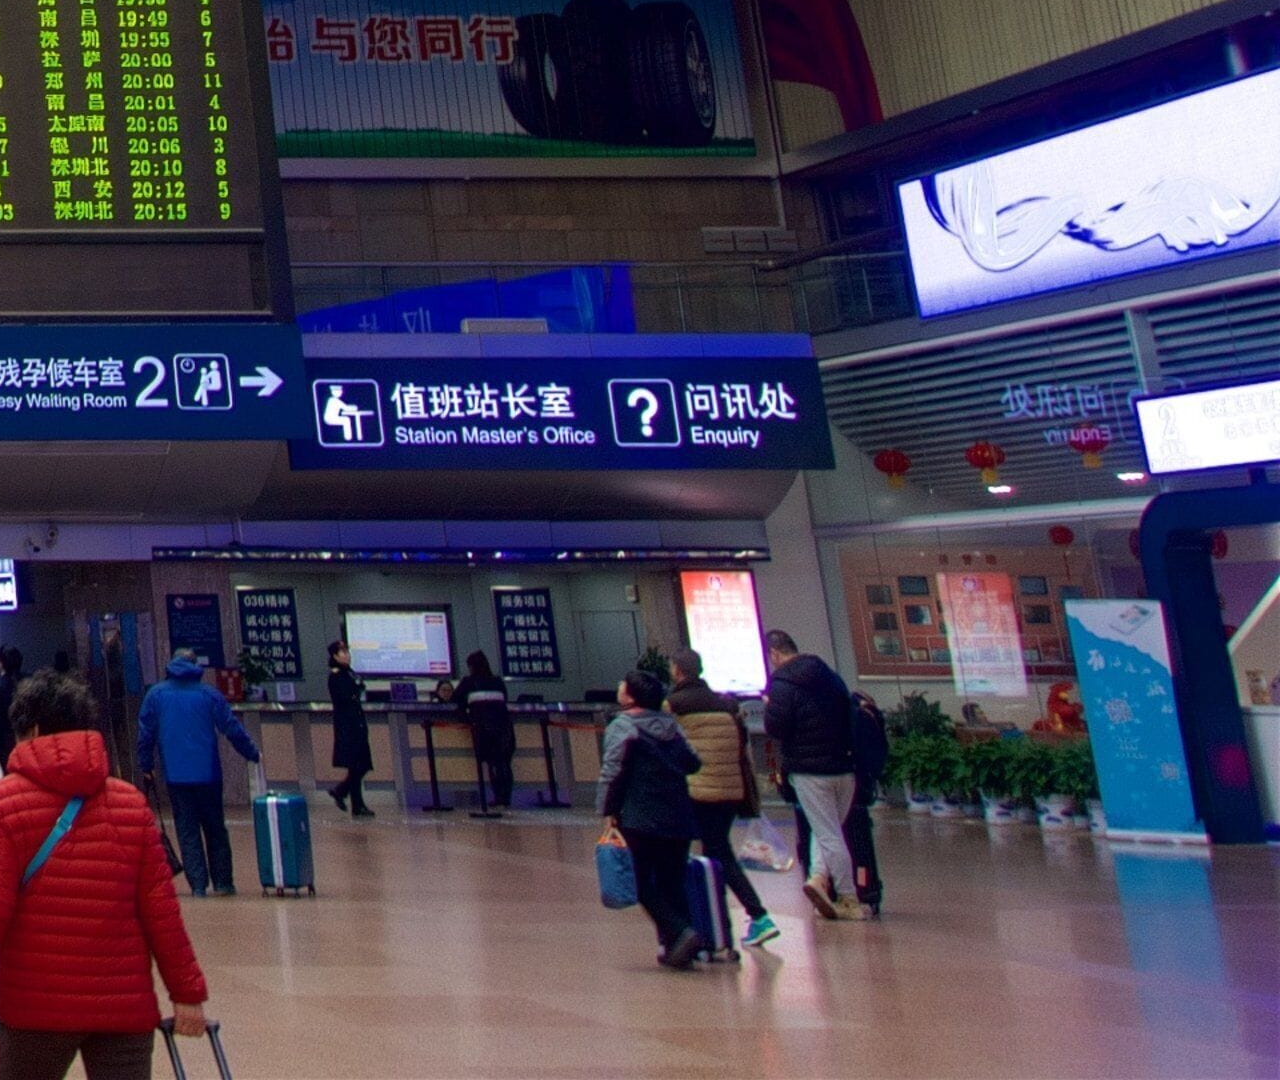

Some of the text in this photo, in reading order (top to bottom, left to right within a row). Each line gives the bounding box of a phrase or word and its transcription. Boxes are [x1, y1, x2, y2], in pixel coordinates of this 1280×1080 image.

[312, 16, 518, 64] 与您同行
[50, 156, 110, 177] 深圳北
[129, 159, 183, 177] 20:10
[215, 158, 227, 176] 8
[53, 200, 114, 221] 深圳北
[133, 202, 187, 221] 20:15
[219, 202, 231, 220] 9
[133, 356, 168, 407] 2
[20, 393, 80, 411] Waiting
[83, 393, 127, 407] Room
[391, 383, 574, 419] 值班站长室
[685, 383, 796, 419] 问讯处
[395, 426, 595, 444] Station Master's Office
[691, 426, 759, 448] Enquiry
[501, 595, 547, 608] 服务项目
